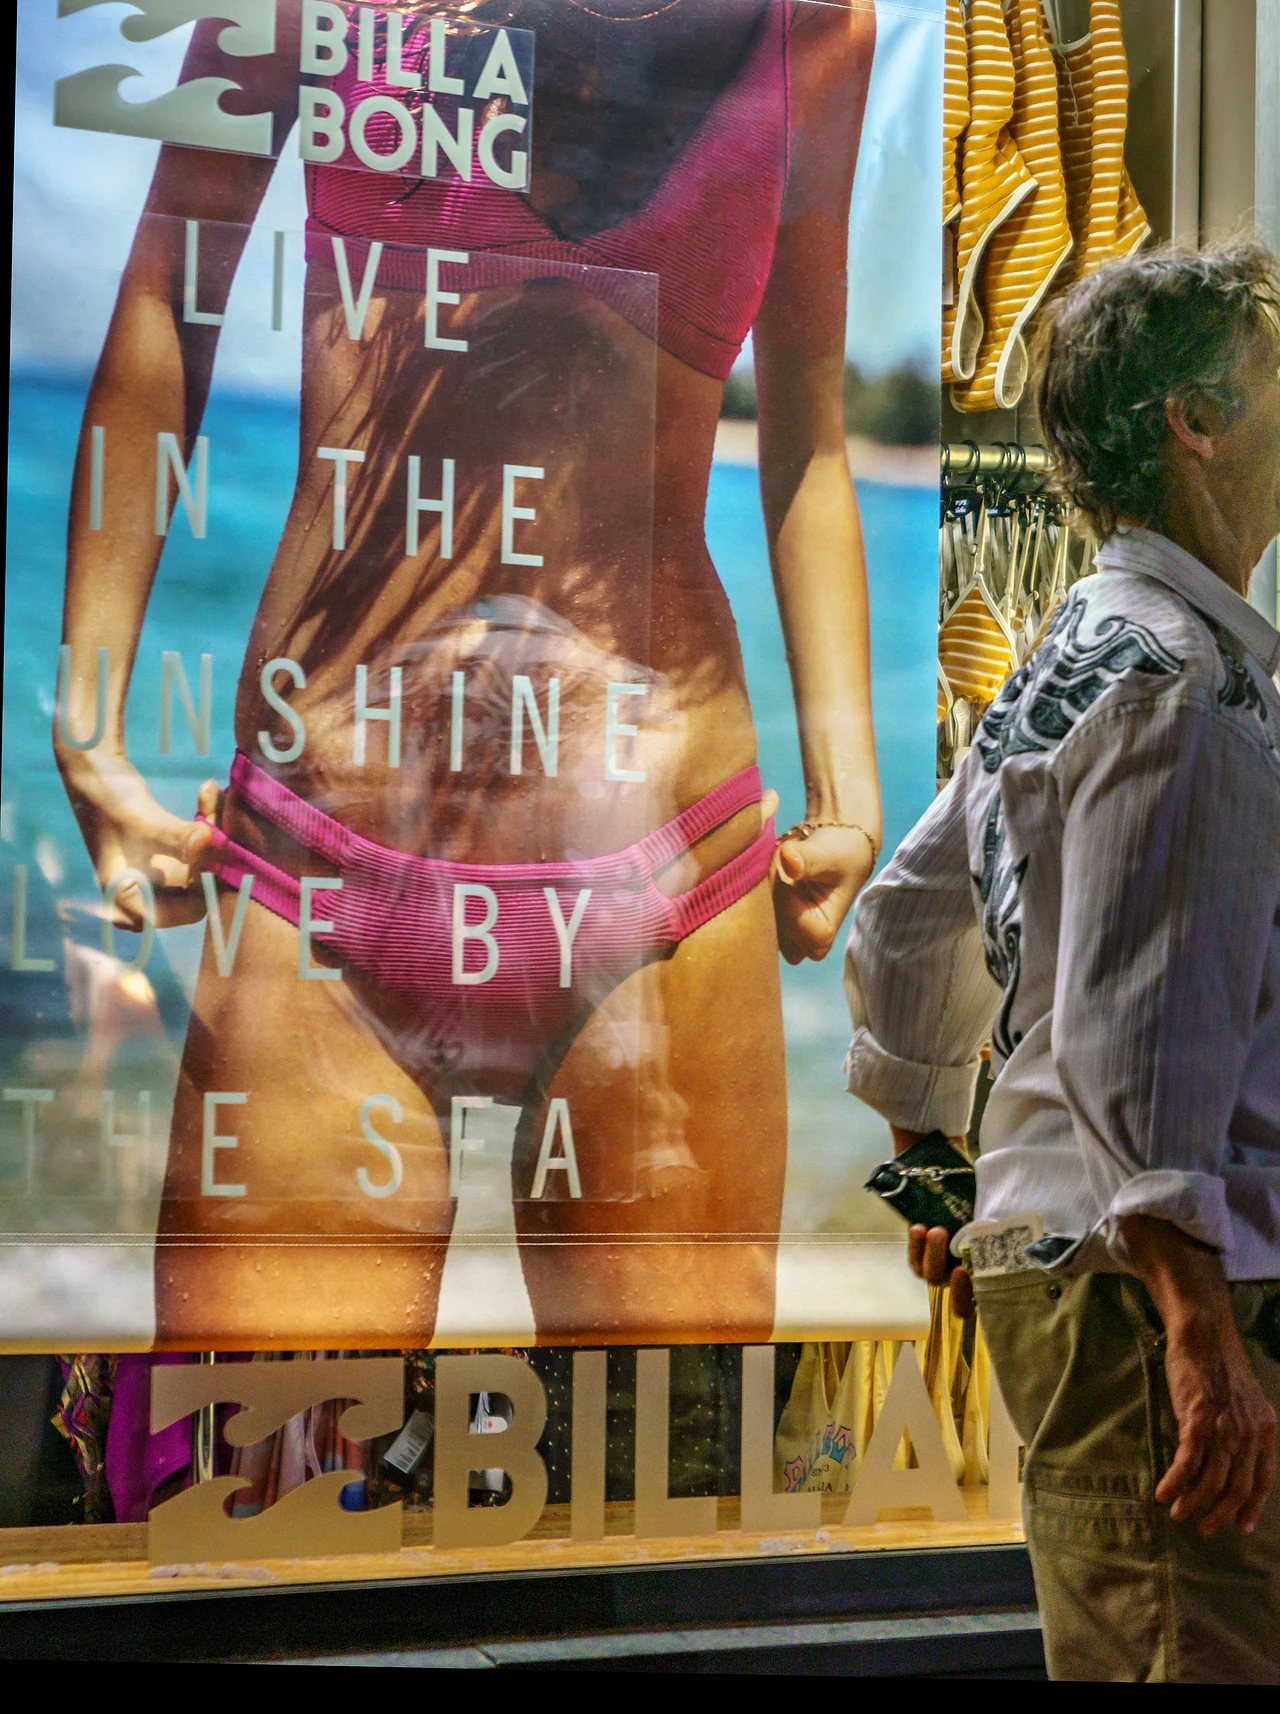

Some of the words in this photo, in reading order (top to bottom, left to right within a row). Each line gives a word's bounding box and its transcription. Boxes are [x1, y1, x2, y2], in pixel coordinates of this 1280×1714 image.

[299, 3, 529, 105] BILLA
[299, 84, 529, 190] BONG
[183, 219, 470, 352] LIVE
[89, 425, 209, 539] IN
[316, 446, 545, 567] THE
[11, 864, 343, 981] LOVE
[451, 883, 593, 989] BY
[3, 1087, 249, 1198] THE
[355, 1091, 582, 1199] SEA
